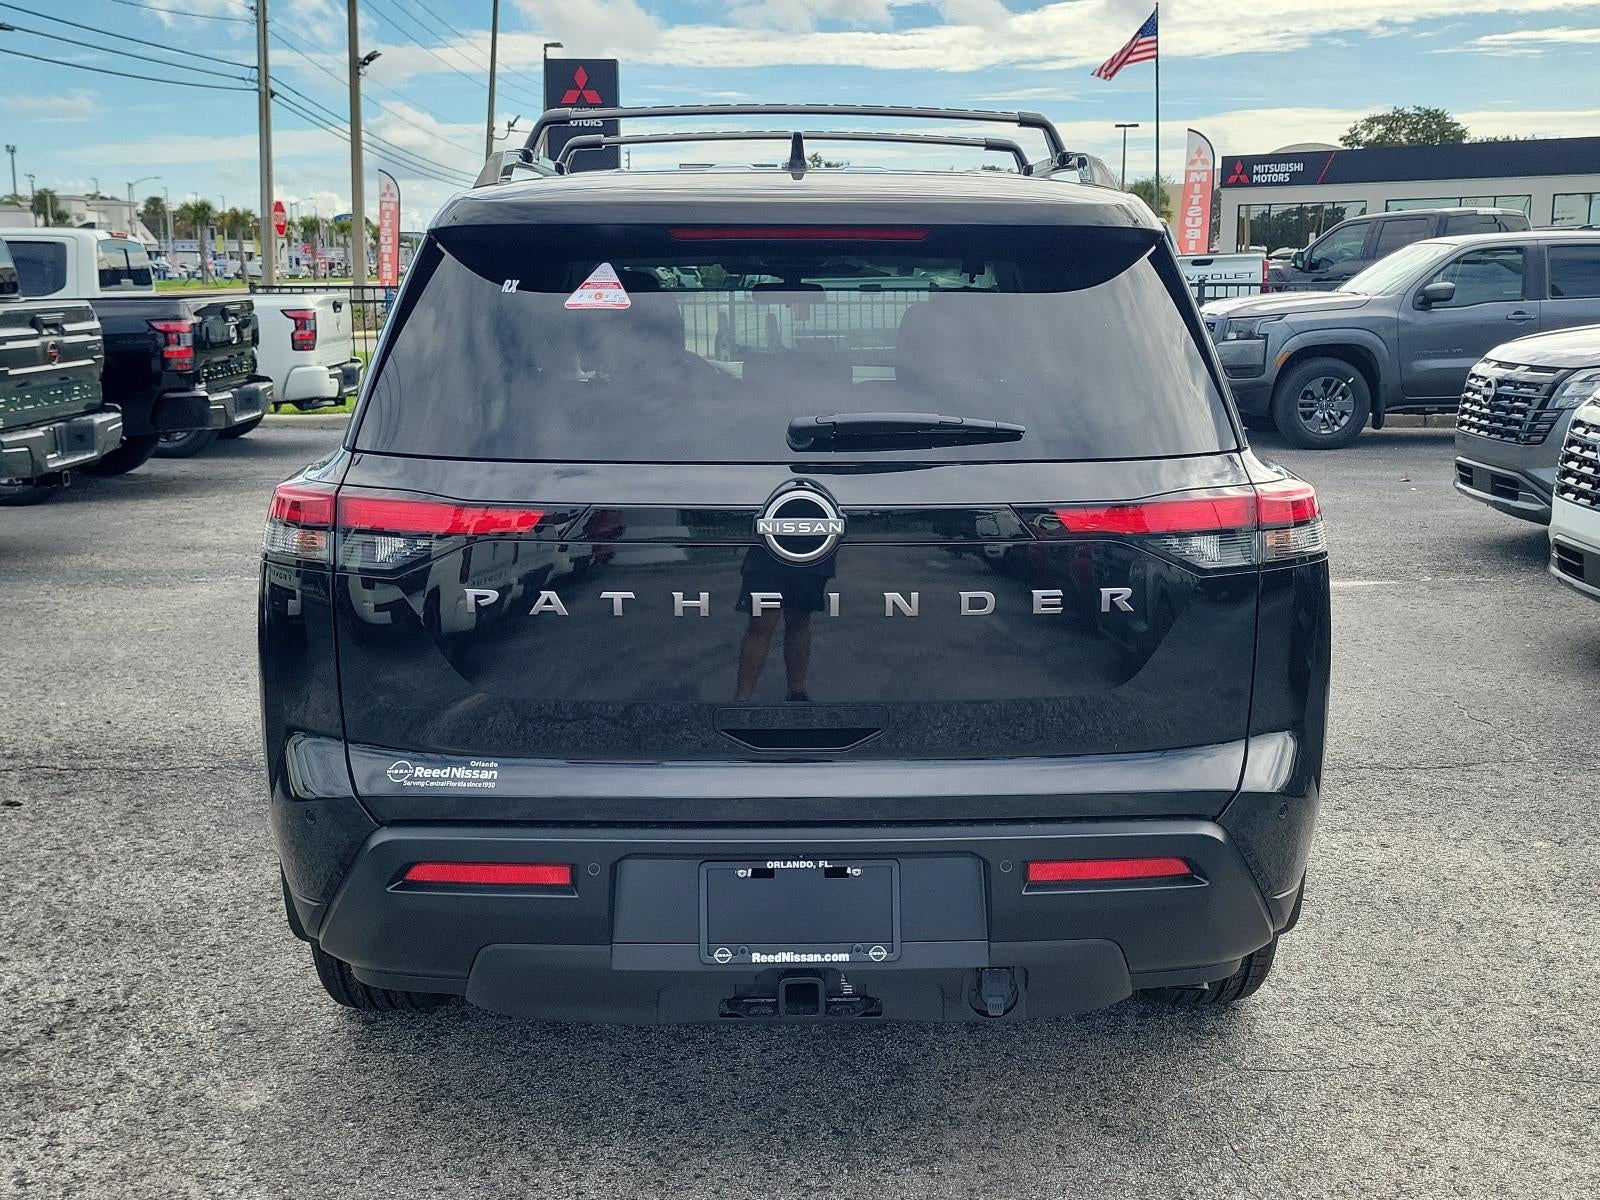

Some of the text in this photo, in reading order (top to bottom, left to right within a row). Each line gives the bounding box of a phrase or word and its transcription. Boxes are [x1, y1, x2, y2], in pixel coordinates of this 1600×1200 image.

[1253, 162, 1304, 173] MITSUBISHI
[1252, 173, 1290, 183] MOTORS
[1186, 272, 1255, 281] VROLET
[759, 521, 842, 533] NISSAN
[464, 587, 1135, 617] PATHFINDER
[470, 760, 499, 768] Orlando
[403, 780, 426, 788] Serving
[766, 860, 833, 870] ORLANDO, FL.
[751, 952, 850, 963] ReedNissan.com
